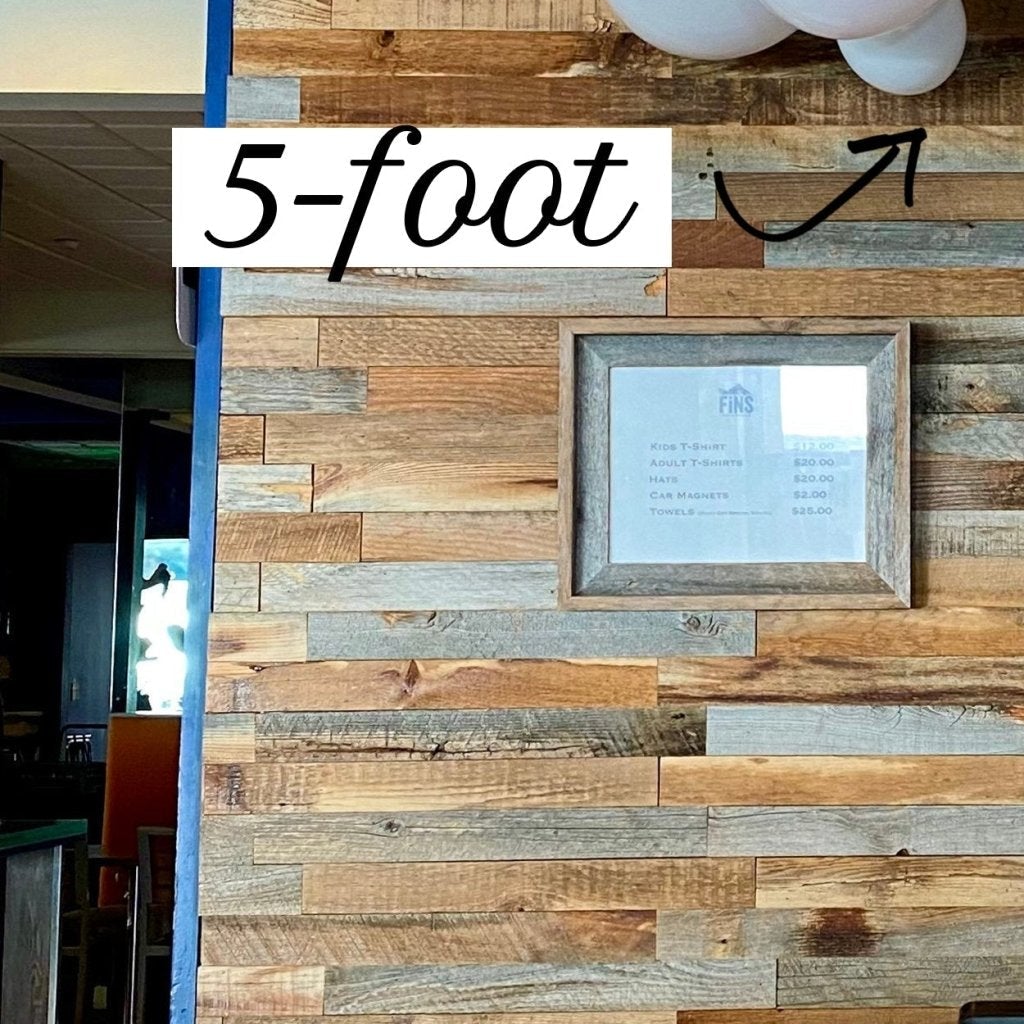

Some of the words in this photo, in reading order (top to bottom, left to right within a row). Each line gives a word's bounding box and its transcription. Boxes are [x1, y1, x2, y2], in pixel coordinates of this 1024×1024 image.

[650, 442, 677, 451] KIDS
[649, 459, 687, 467] ADULT
[690, 459, 743, 467] T-SHIRTS
[793, 458, 835, 467] $20.00
[649, 475, 679, 484] HATS
[793, 475, 835, 484] $20.00
[649, 491, 673, 500] CAR
[677, 491, 729, 500] MAGNETS
[793, 491, 827, 500] $2.00
[649, 507, 695, 516] TOWELS
[791, 507, 833, 516] $25.00
